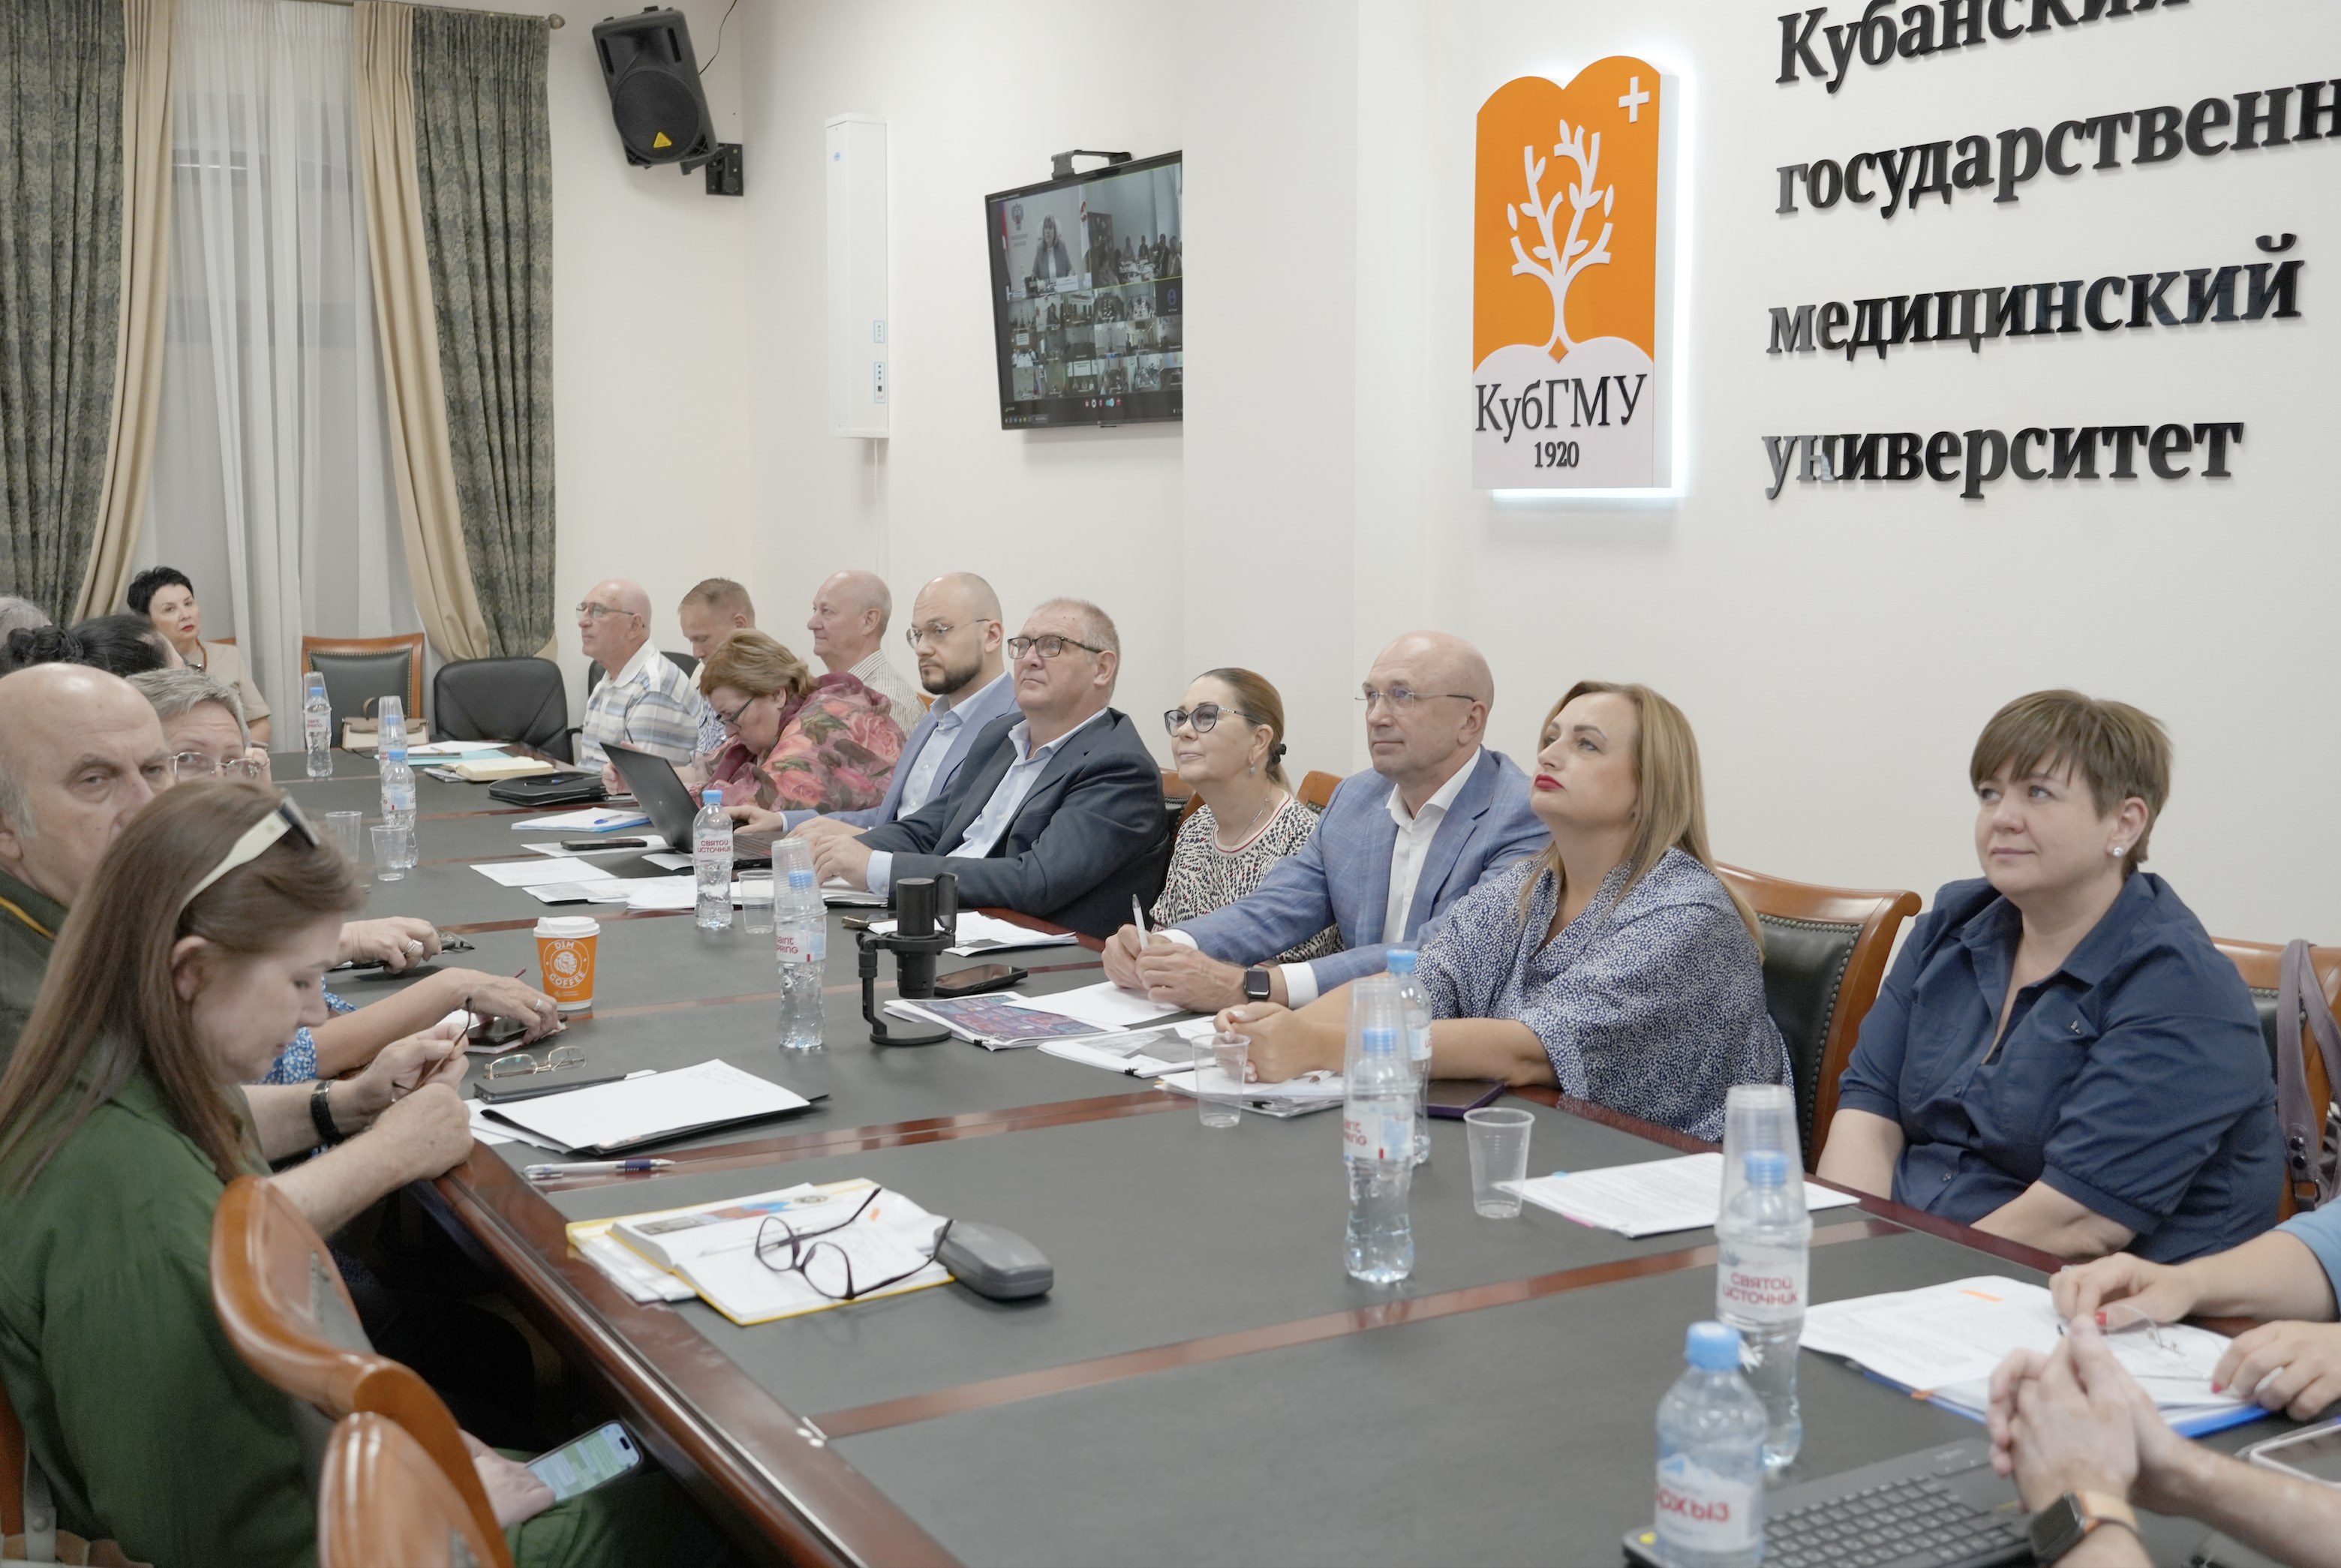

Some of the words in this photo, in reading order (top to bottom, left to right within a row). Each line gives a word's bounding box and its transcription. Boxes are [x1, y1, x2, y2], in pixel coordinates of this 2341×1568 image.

[1776, 78, 2341, 219] государственн
[1766, 233, 2305, 362] медицинский
[1476, 374, 1647, 443] КубГМУ
[1535, 442, 1579, 467] 1920
[1762, 422, 2244, 500] университет
[554, 940, 575, 950] DIM
[549, 971, 586, 987] COFFEE
[1730, 1272, 1793, 1290] СВЯТОЙ
[1723, 1283, 1799, 1305] ИСТОЧНИК
